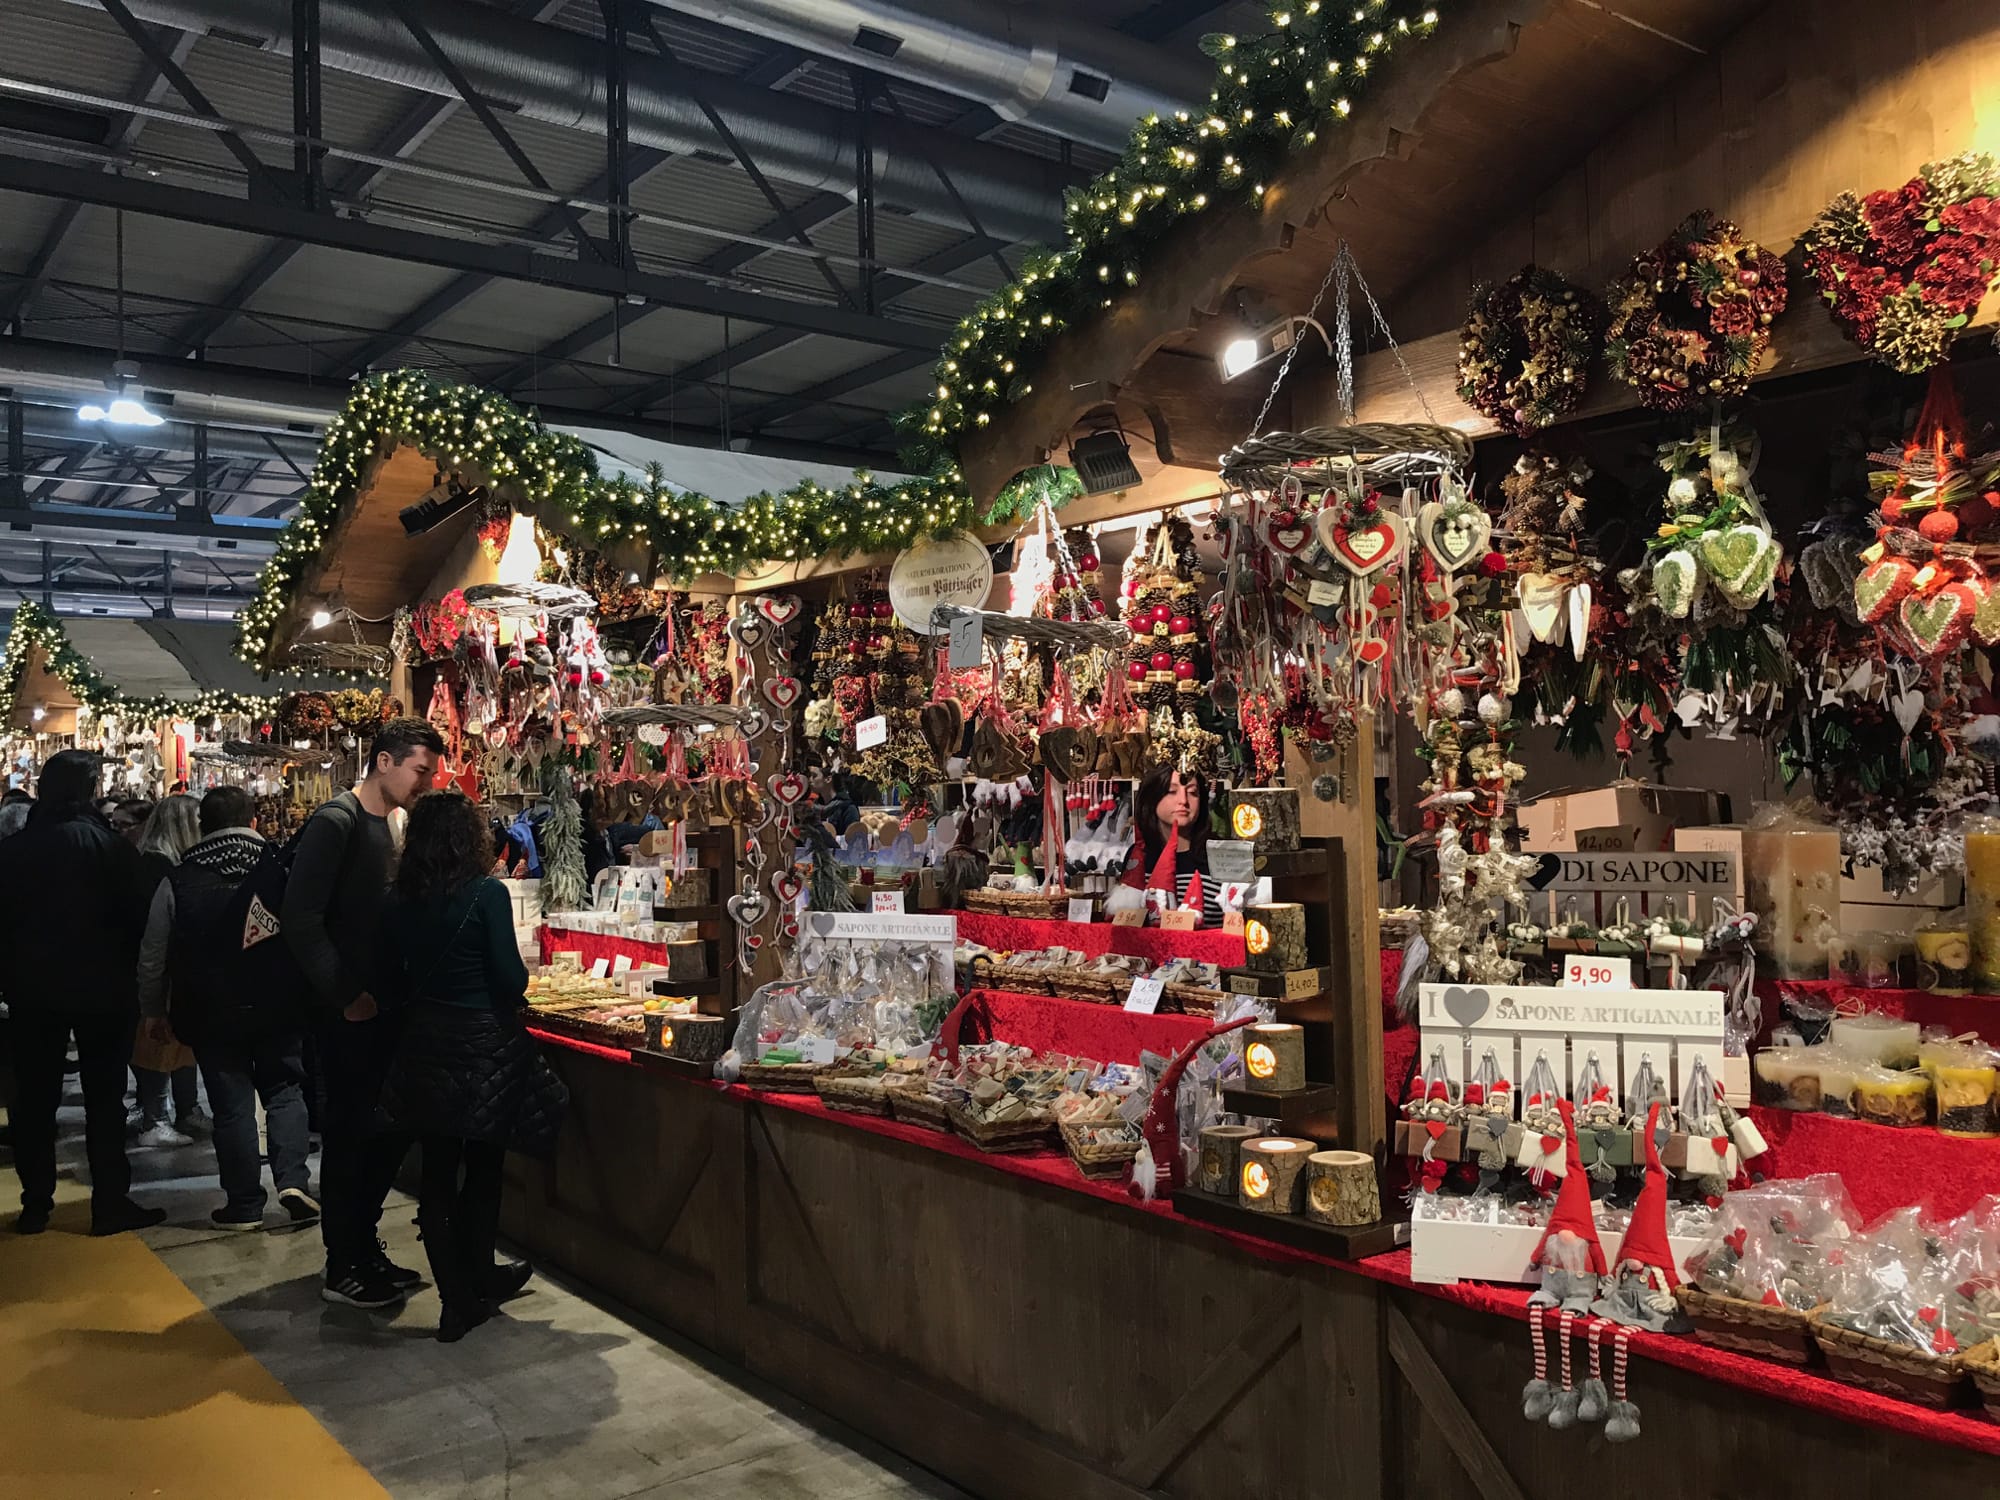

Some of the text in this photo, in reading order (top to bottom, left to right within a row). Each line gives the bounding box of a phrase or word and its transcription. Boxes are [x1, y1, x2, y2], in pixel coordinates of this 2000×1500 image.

[1579, 835, 1623, 851] 12,00
[1562, 860, 1729, 884] DI SAPONE
[250, 902, 280, 934] GUESS
[837, 923, 877, 934] SAPONE
[880, 924, 951, 937] ARTIGIANALE
[1569, 965, 1613, 987] 9,90
[1425, 991, 1722, 1026] I SAPONE ARTIGIANALE
